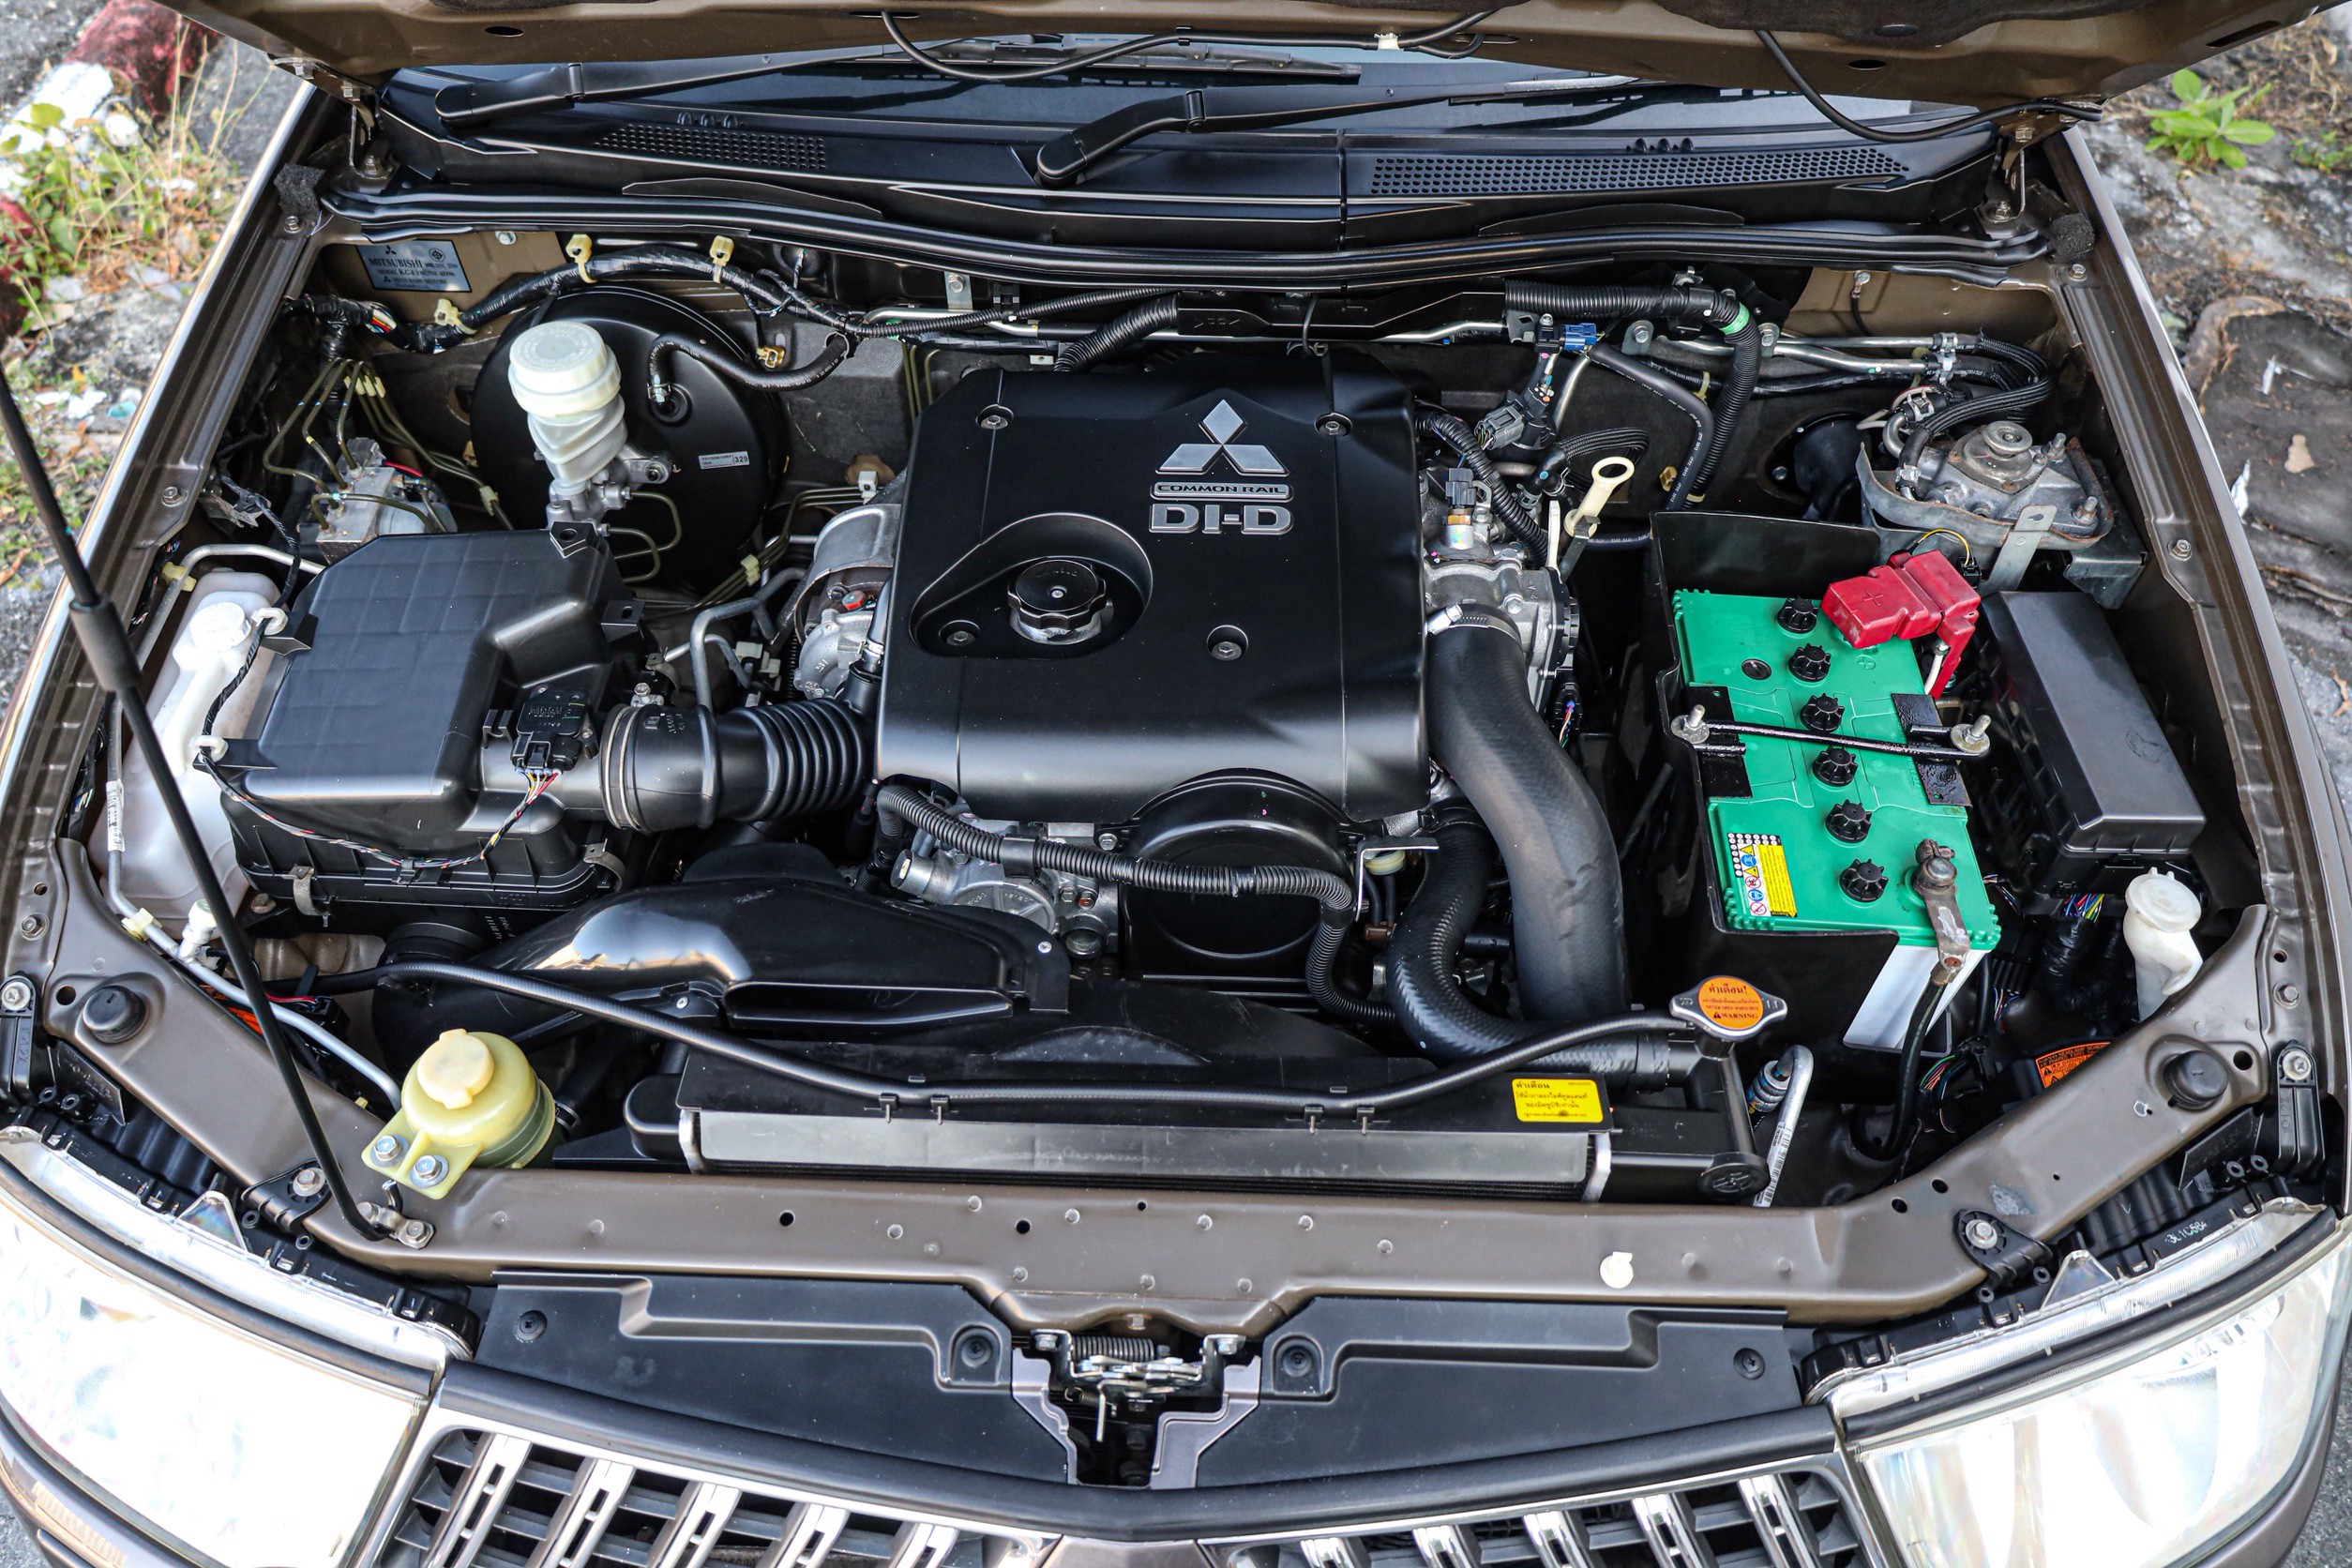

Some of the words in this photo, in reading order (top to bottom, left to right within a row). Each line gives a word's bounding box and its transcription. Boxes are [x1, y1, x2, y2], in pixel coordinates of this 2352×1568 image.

[369, 258, 423, 268] MITSUBISHI
[1243, 486, 1286, 494] RAIL
[1150, 504, 1292, 535] DI-D
